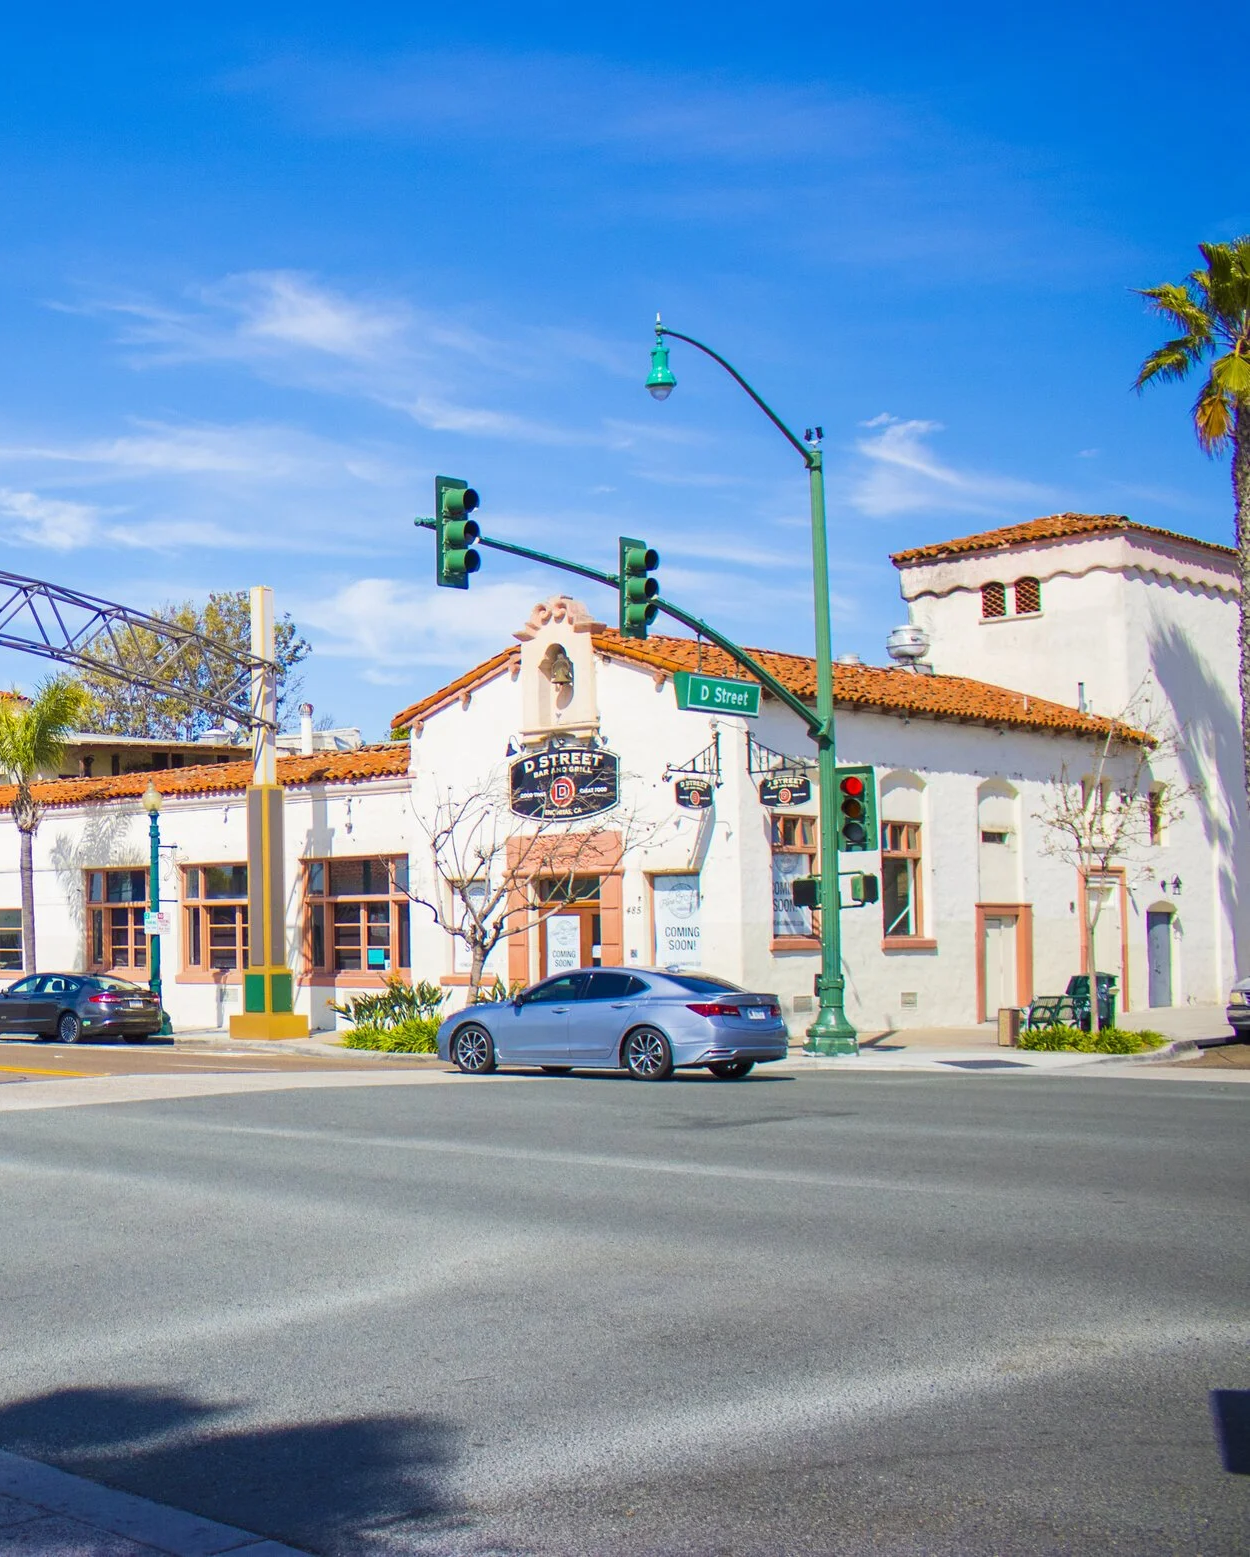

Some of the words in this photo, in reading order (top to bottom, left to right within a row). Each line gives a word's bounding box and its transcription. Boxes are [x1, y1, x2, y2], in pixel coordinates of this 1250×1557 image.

[700, 685, 710, 701] D
[714, 686, 749, 706] Street
[524, 760, 536, 774] D
[538, 752, 604, 769] STREET
[533, 768, 550, 779] BAR
[550, 766, 568, 775] AND
[568, 765, 593, 774] GRILL
[554, 783, 570, 800] D
[626, 907, 642, 915] 485
[665, 926, 700, 938] COMING
[668, 939, 697, 951] SOON!
[552, 950, 577, 959] COMING
[555, 959, 574, 968] SOON!
